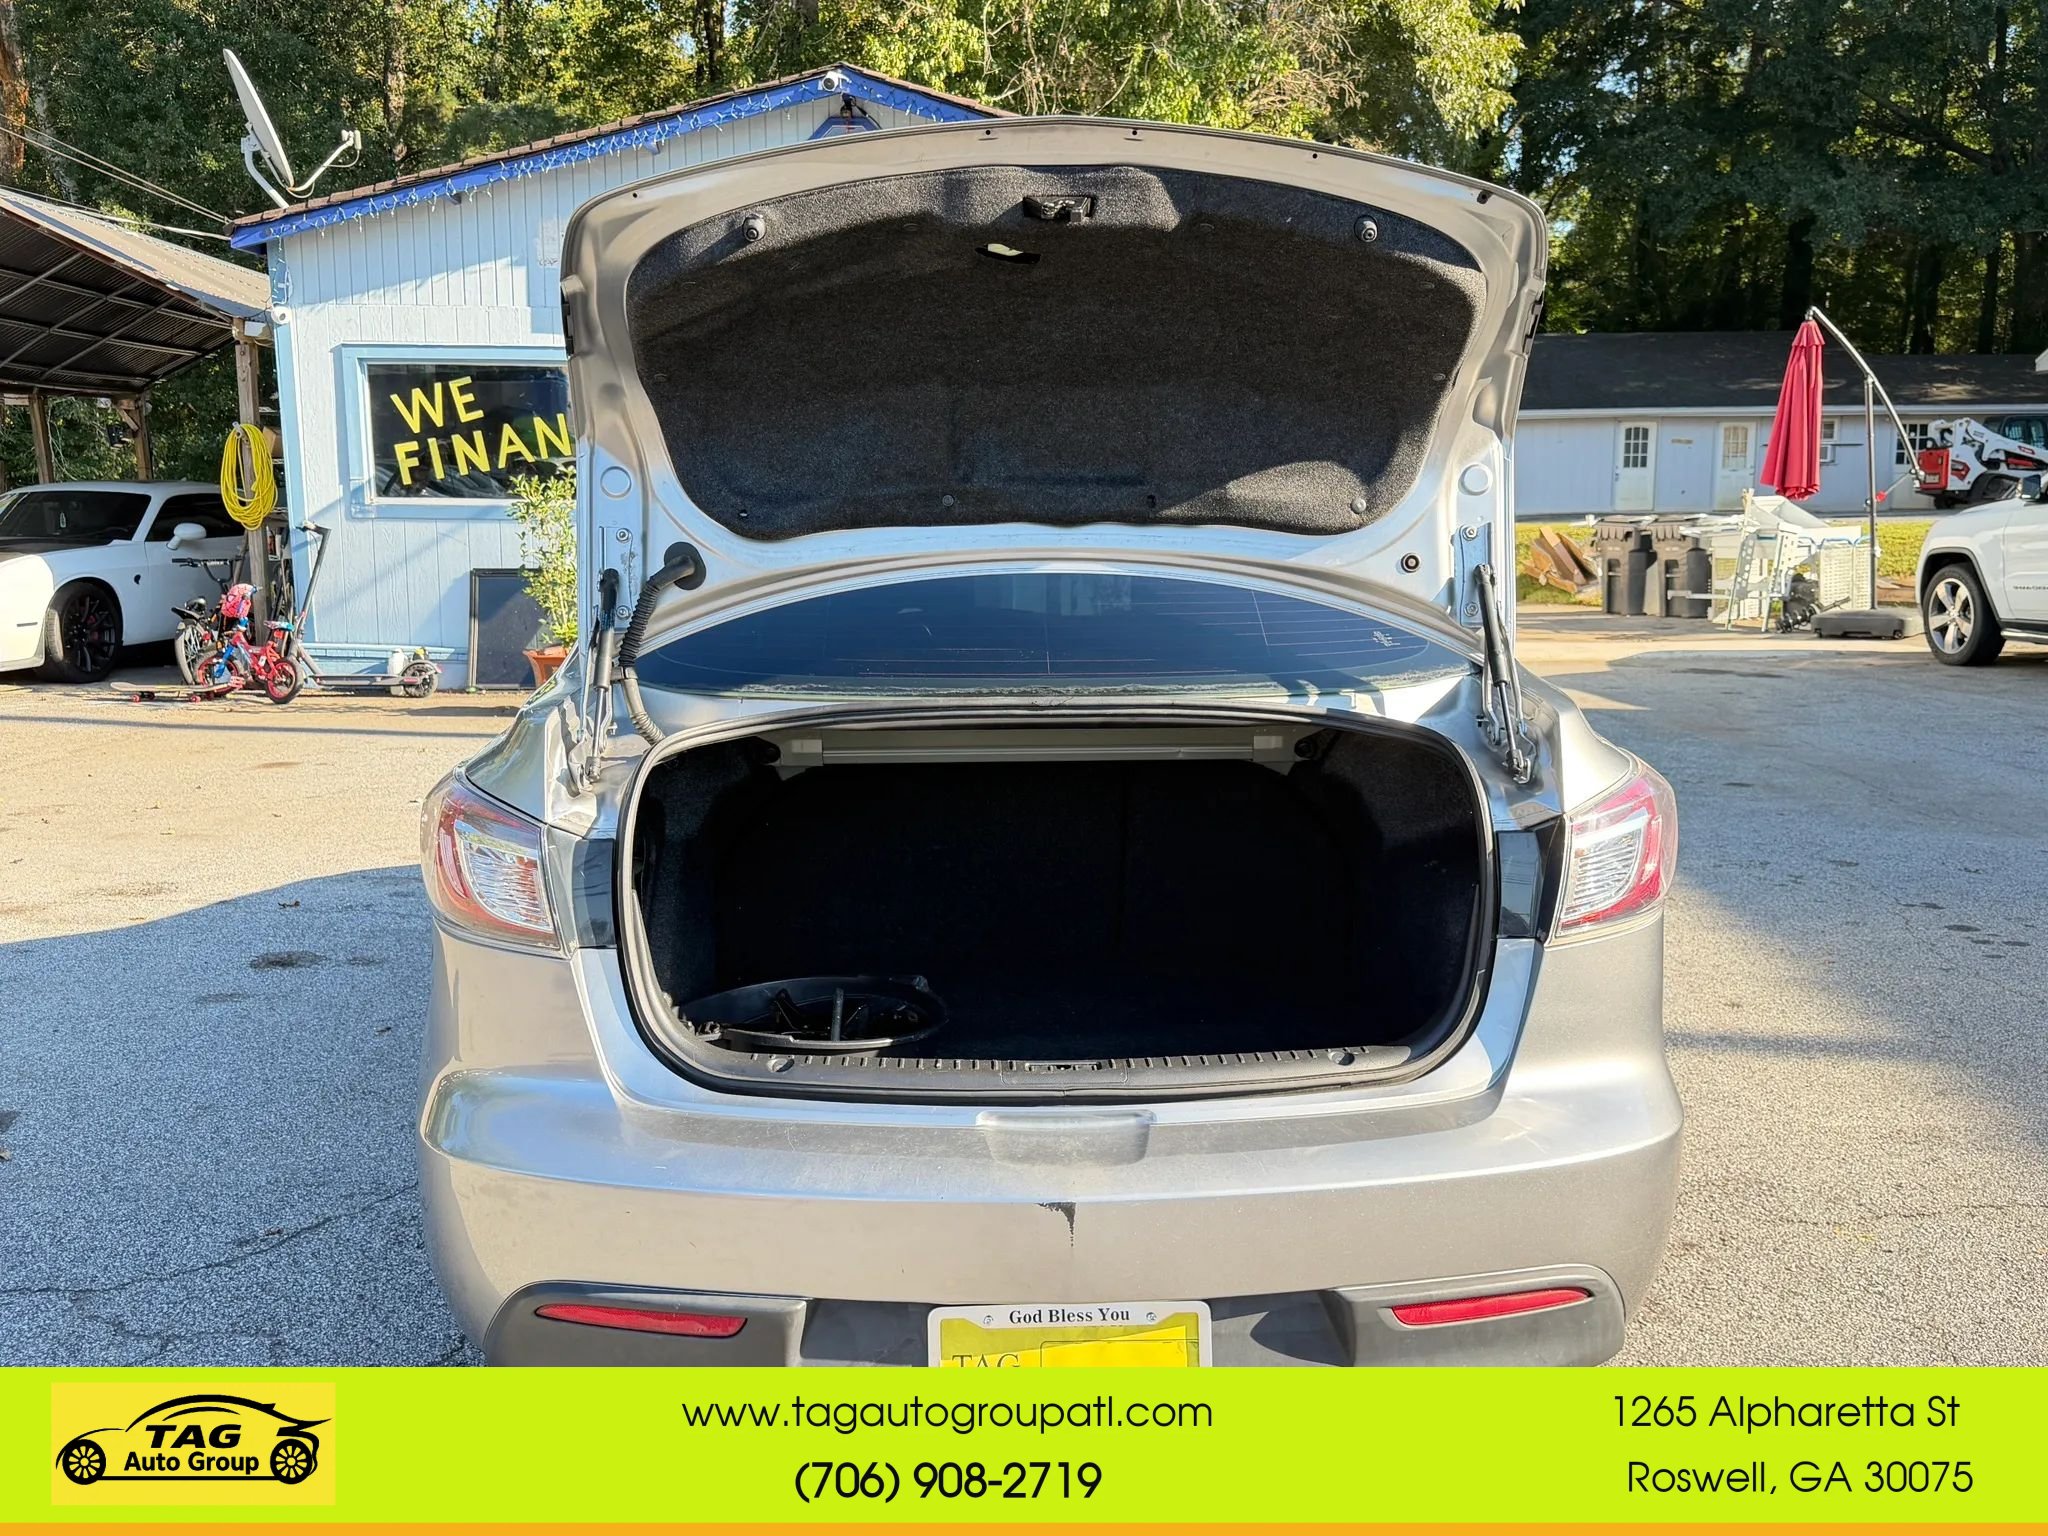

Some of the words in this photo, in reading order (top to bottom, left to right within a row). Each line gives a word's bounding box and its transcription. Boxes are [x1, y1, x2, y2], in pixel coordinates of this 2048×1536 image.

[390, 376, 484, 434] WE
[393, 413, 573, 486] FINAN
[1009, 1309, 1043, 1325] God
[1048, 1308, 1093, 1323] Bless
[1098, 1307, 1130, 1322] You
